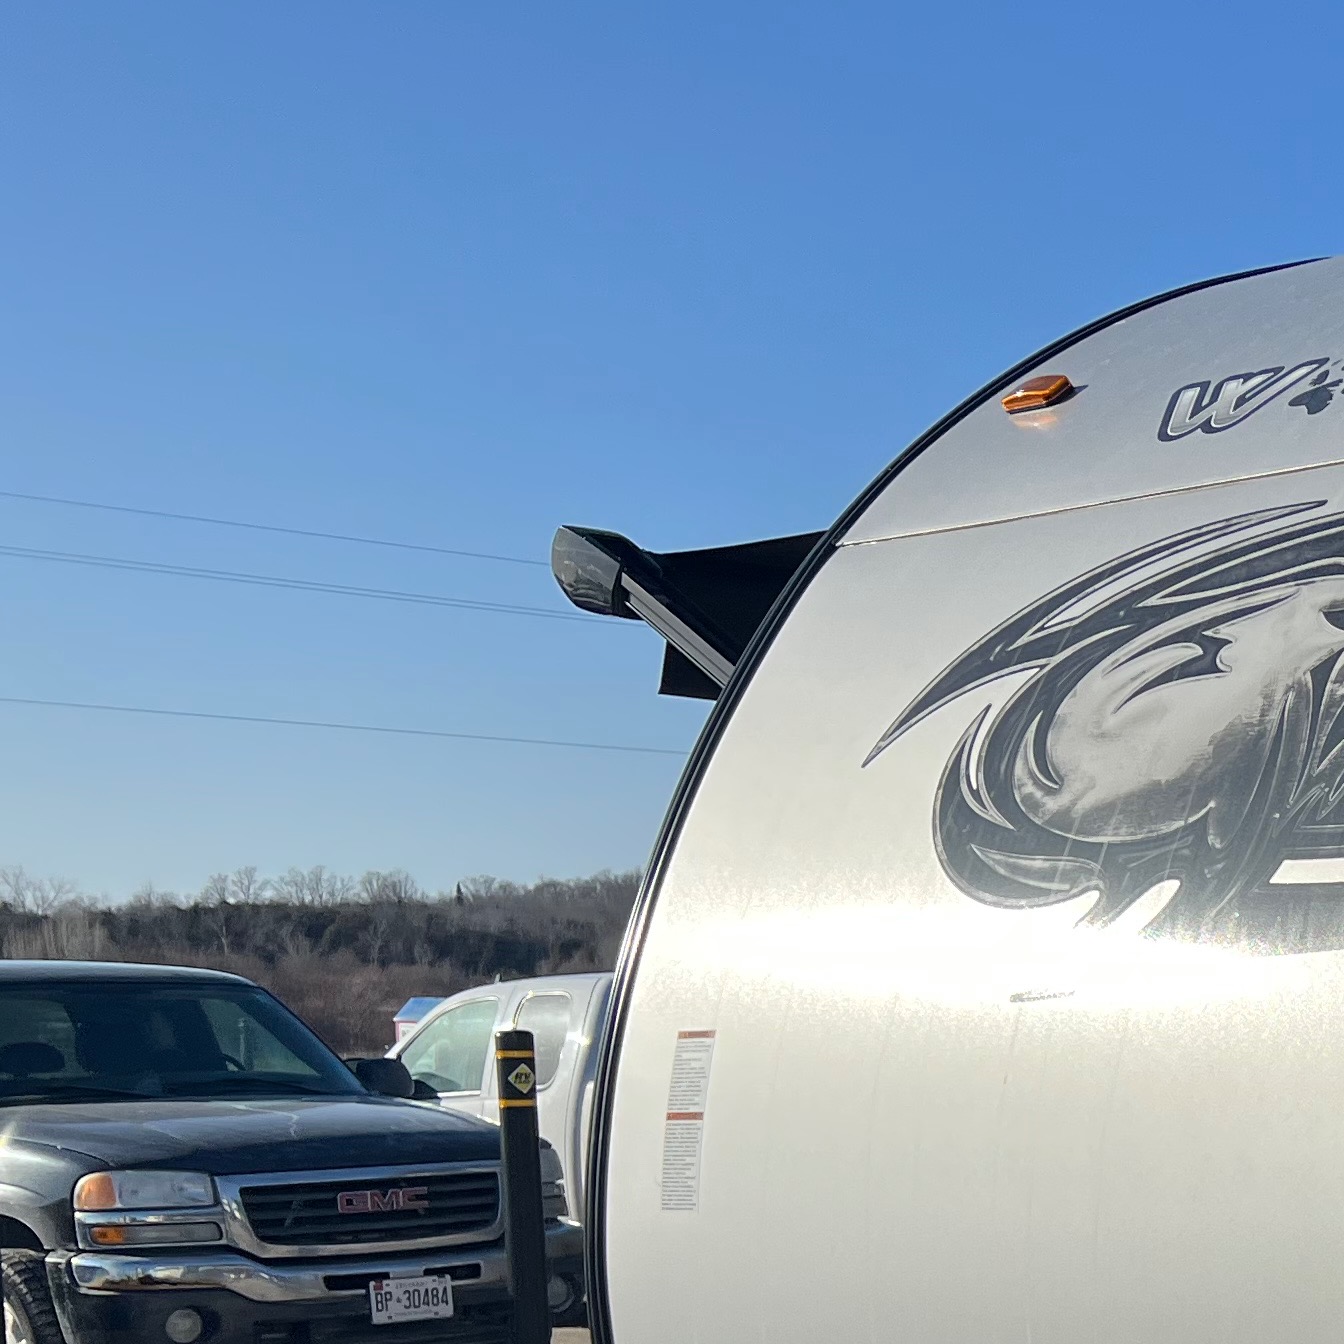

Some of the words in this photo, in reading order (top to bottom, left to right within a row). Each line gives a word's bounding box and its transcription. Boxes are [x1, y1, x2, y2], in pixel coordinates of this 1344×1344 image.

[337, 1186, 430, 1214] GMC
[375, 1290, 393, 1312] BP
[402, 1285, 449, 1309] 30484
